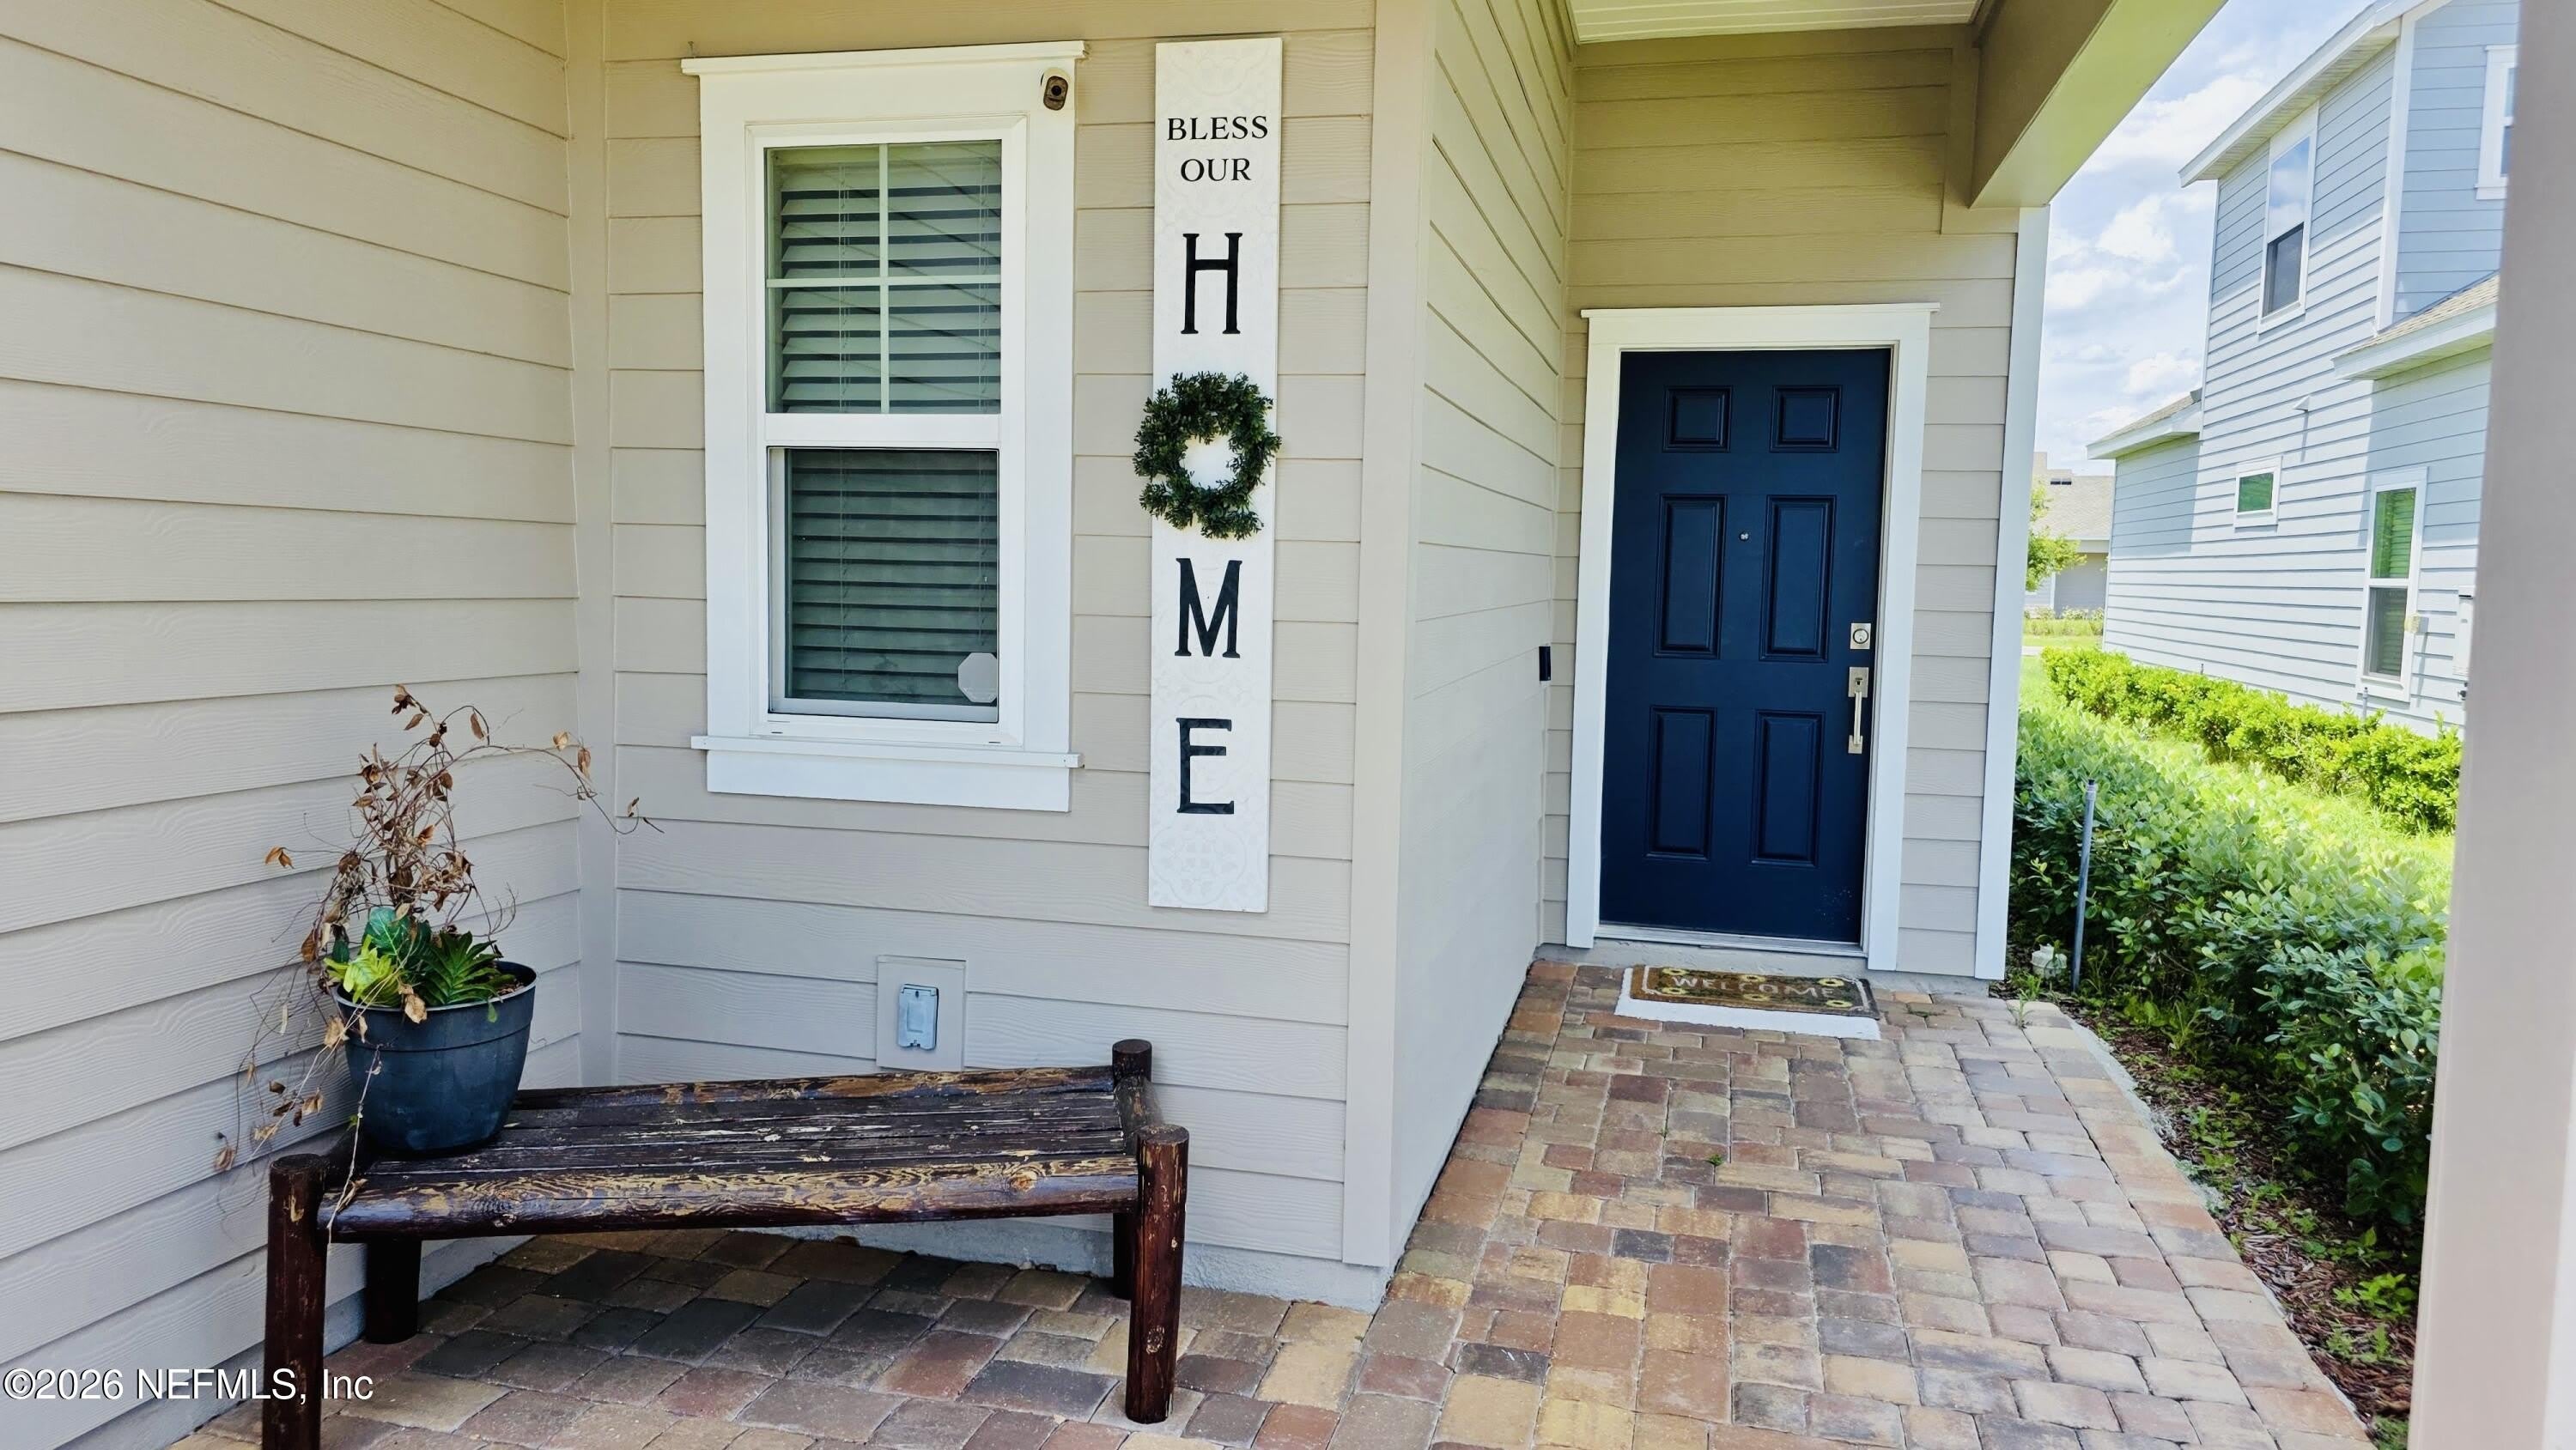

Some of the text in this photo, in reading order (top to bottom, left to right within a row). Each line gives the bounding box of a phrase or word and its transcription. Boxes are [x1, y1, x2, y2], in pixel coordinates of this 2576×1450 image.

[1167, 115, 1268, 141] BLESS
[1180, 157, 1252, 182] OUR
[1671, 975, 1835, 998] WELCOME
